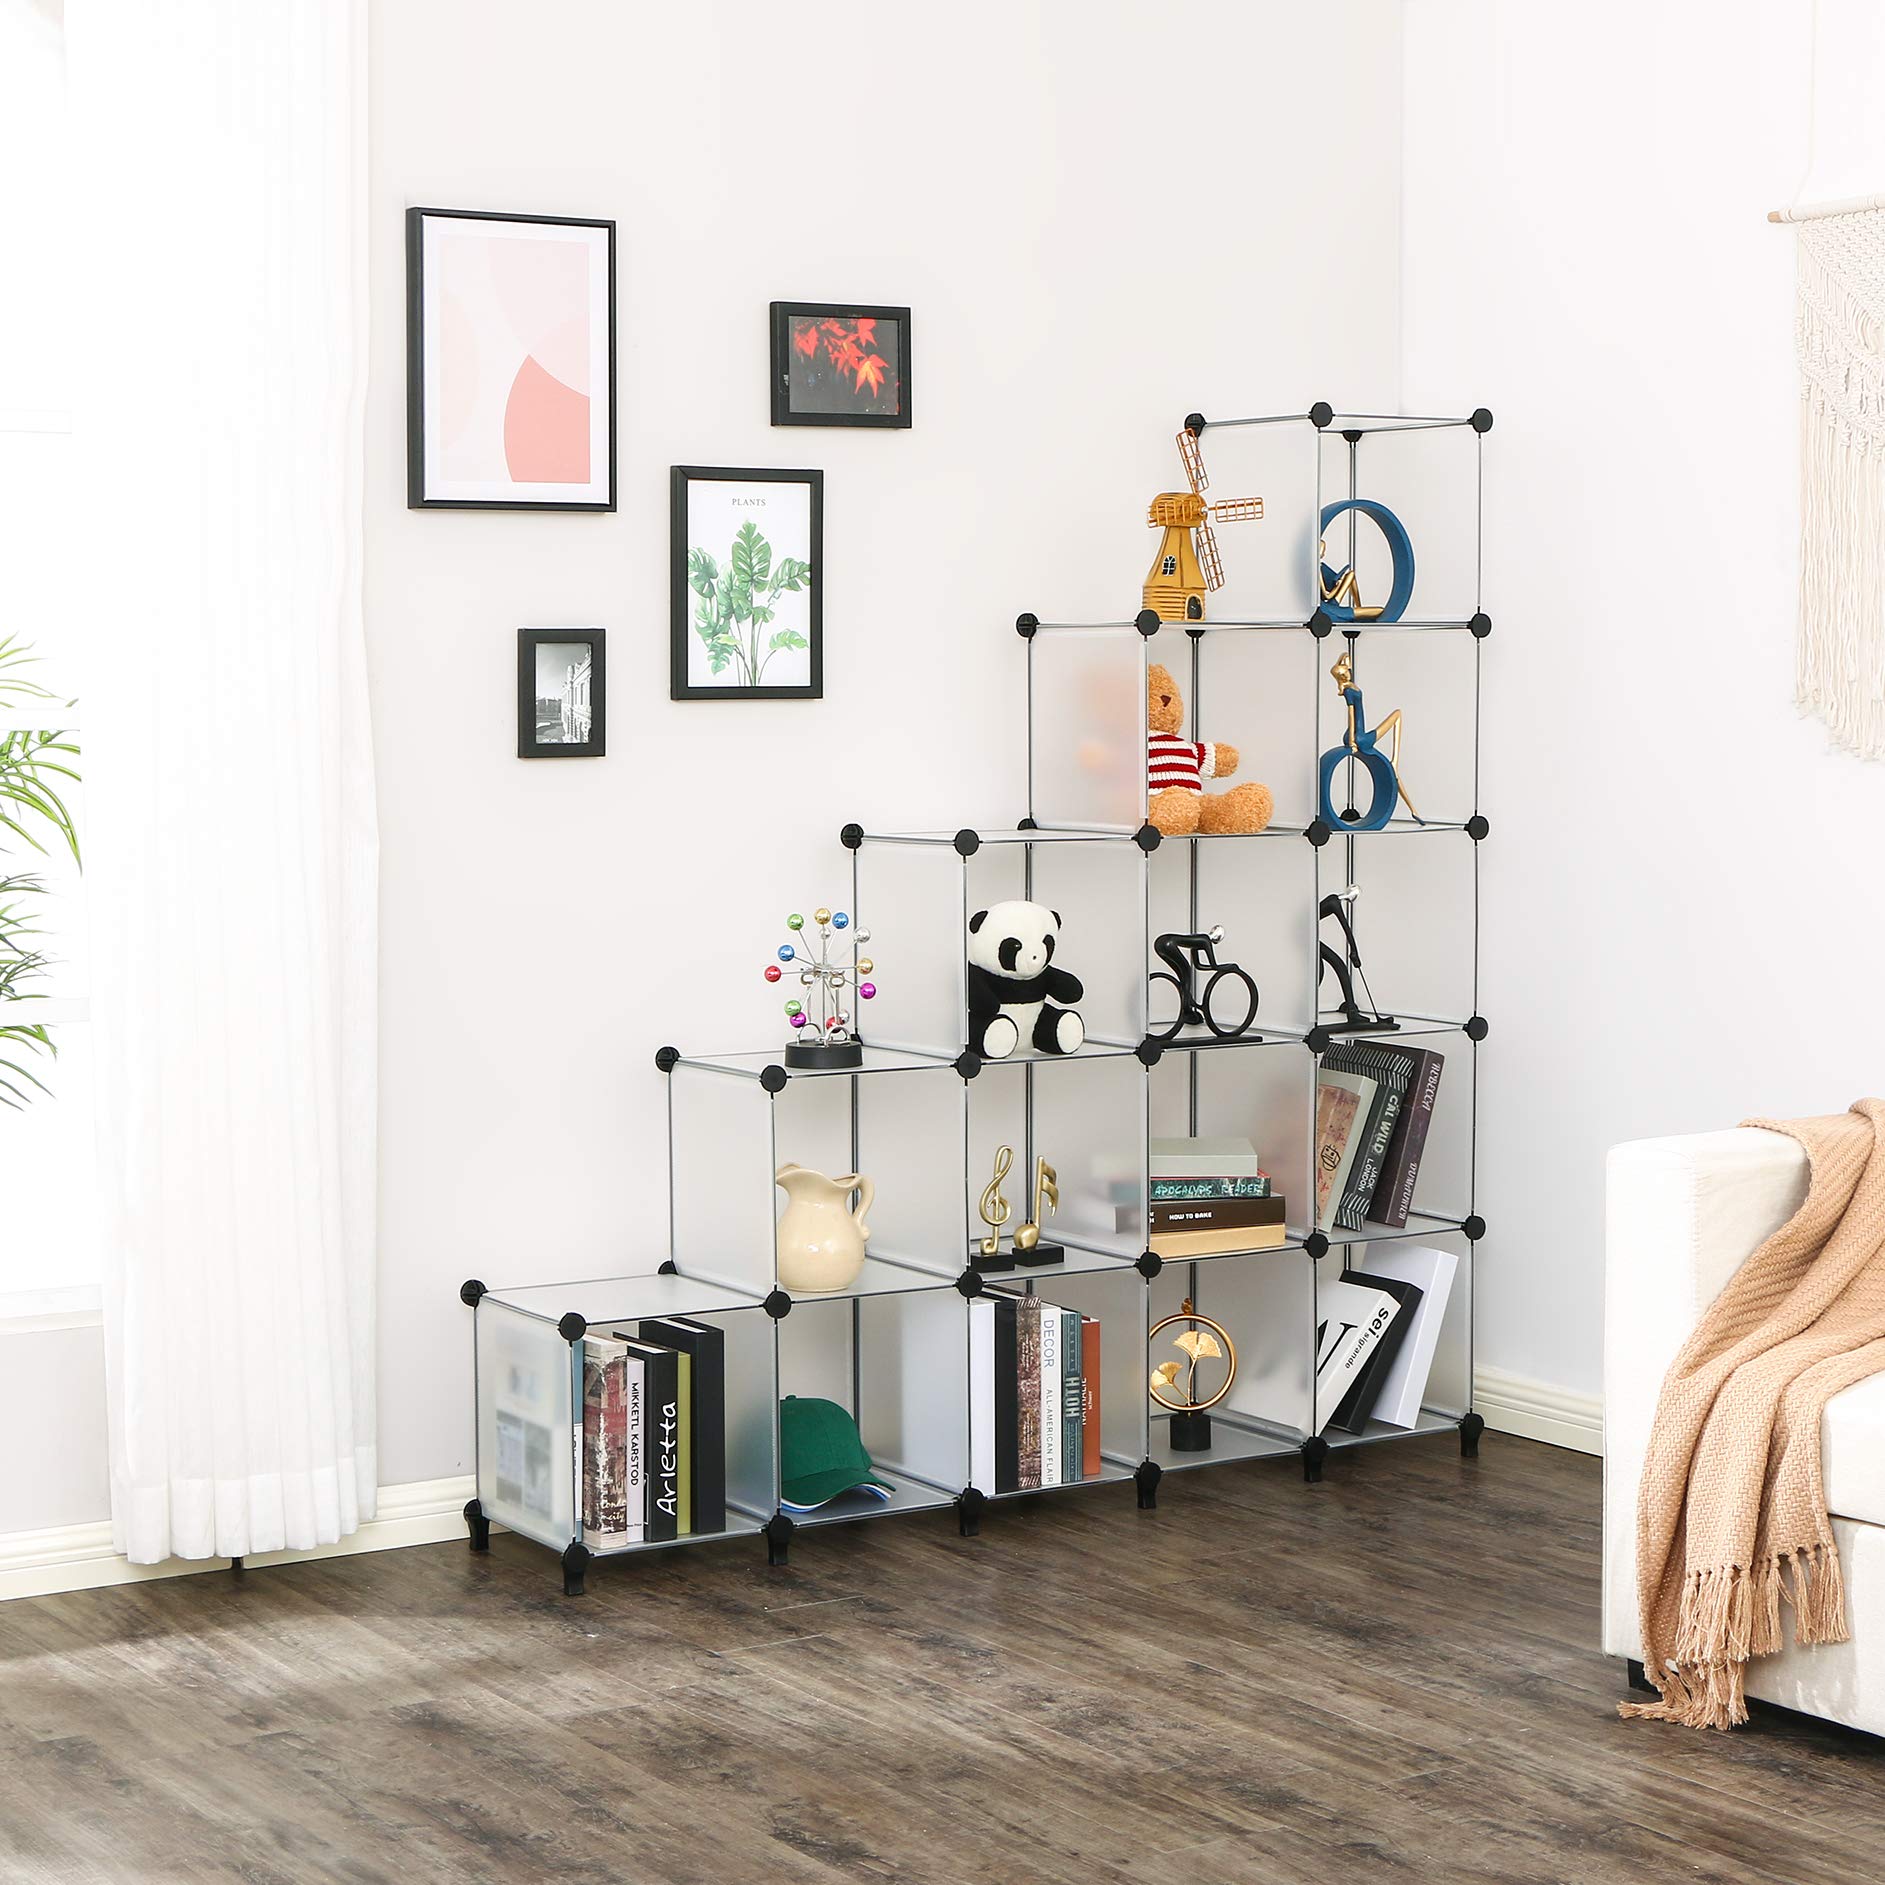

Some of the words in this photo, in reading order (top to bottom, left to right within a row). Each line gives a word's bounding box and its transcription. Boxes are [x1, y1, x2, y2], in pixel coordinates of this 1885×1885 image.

[731, 497, 767, 507] PLANTS
[1422, 1062, 1441, 1112] REBECCA
[1373, 1121, 1392, 1154] WILD
[1358, 1157, 1375, 1193] LONDON
[1368, 1166, 1379, 1190] JACK
[1370, 1306, 1389, 1339] sei
[1043, 1319, 1055, 1369] DECOR
[631, 1382, 639, 1430] MIKKETL
[1065, 1376, 1080, 1418] HOTH
[1046, 1389, 1054, 1454] ALL-AMERICAN
[631, 1433, 640, 1486] KARSTOD
[1046, 1457, 1054, 1484] FLAIR
